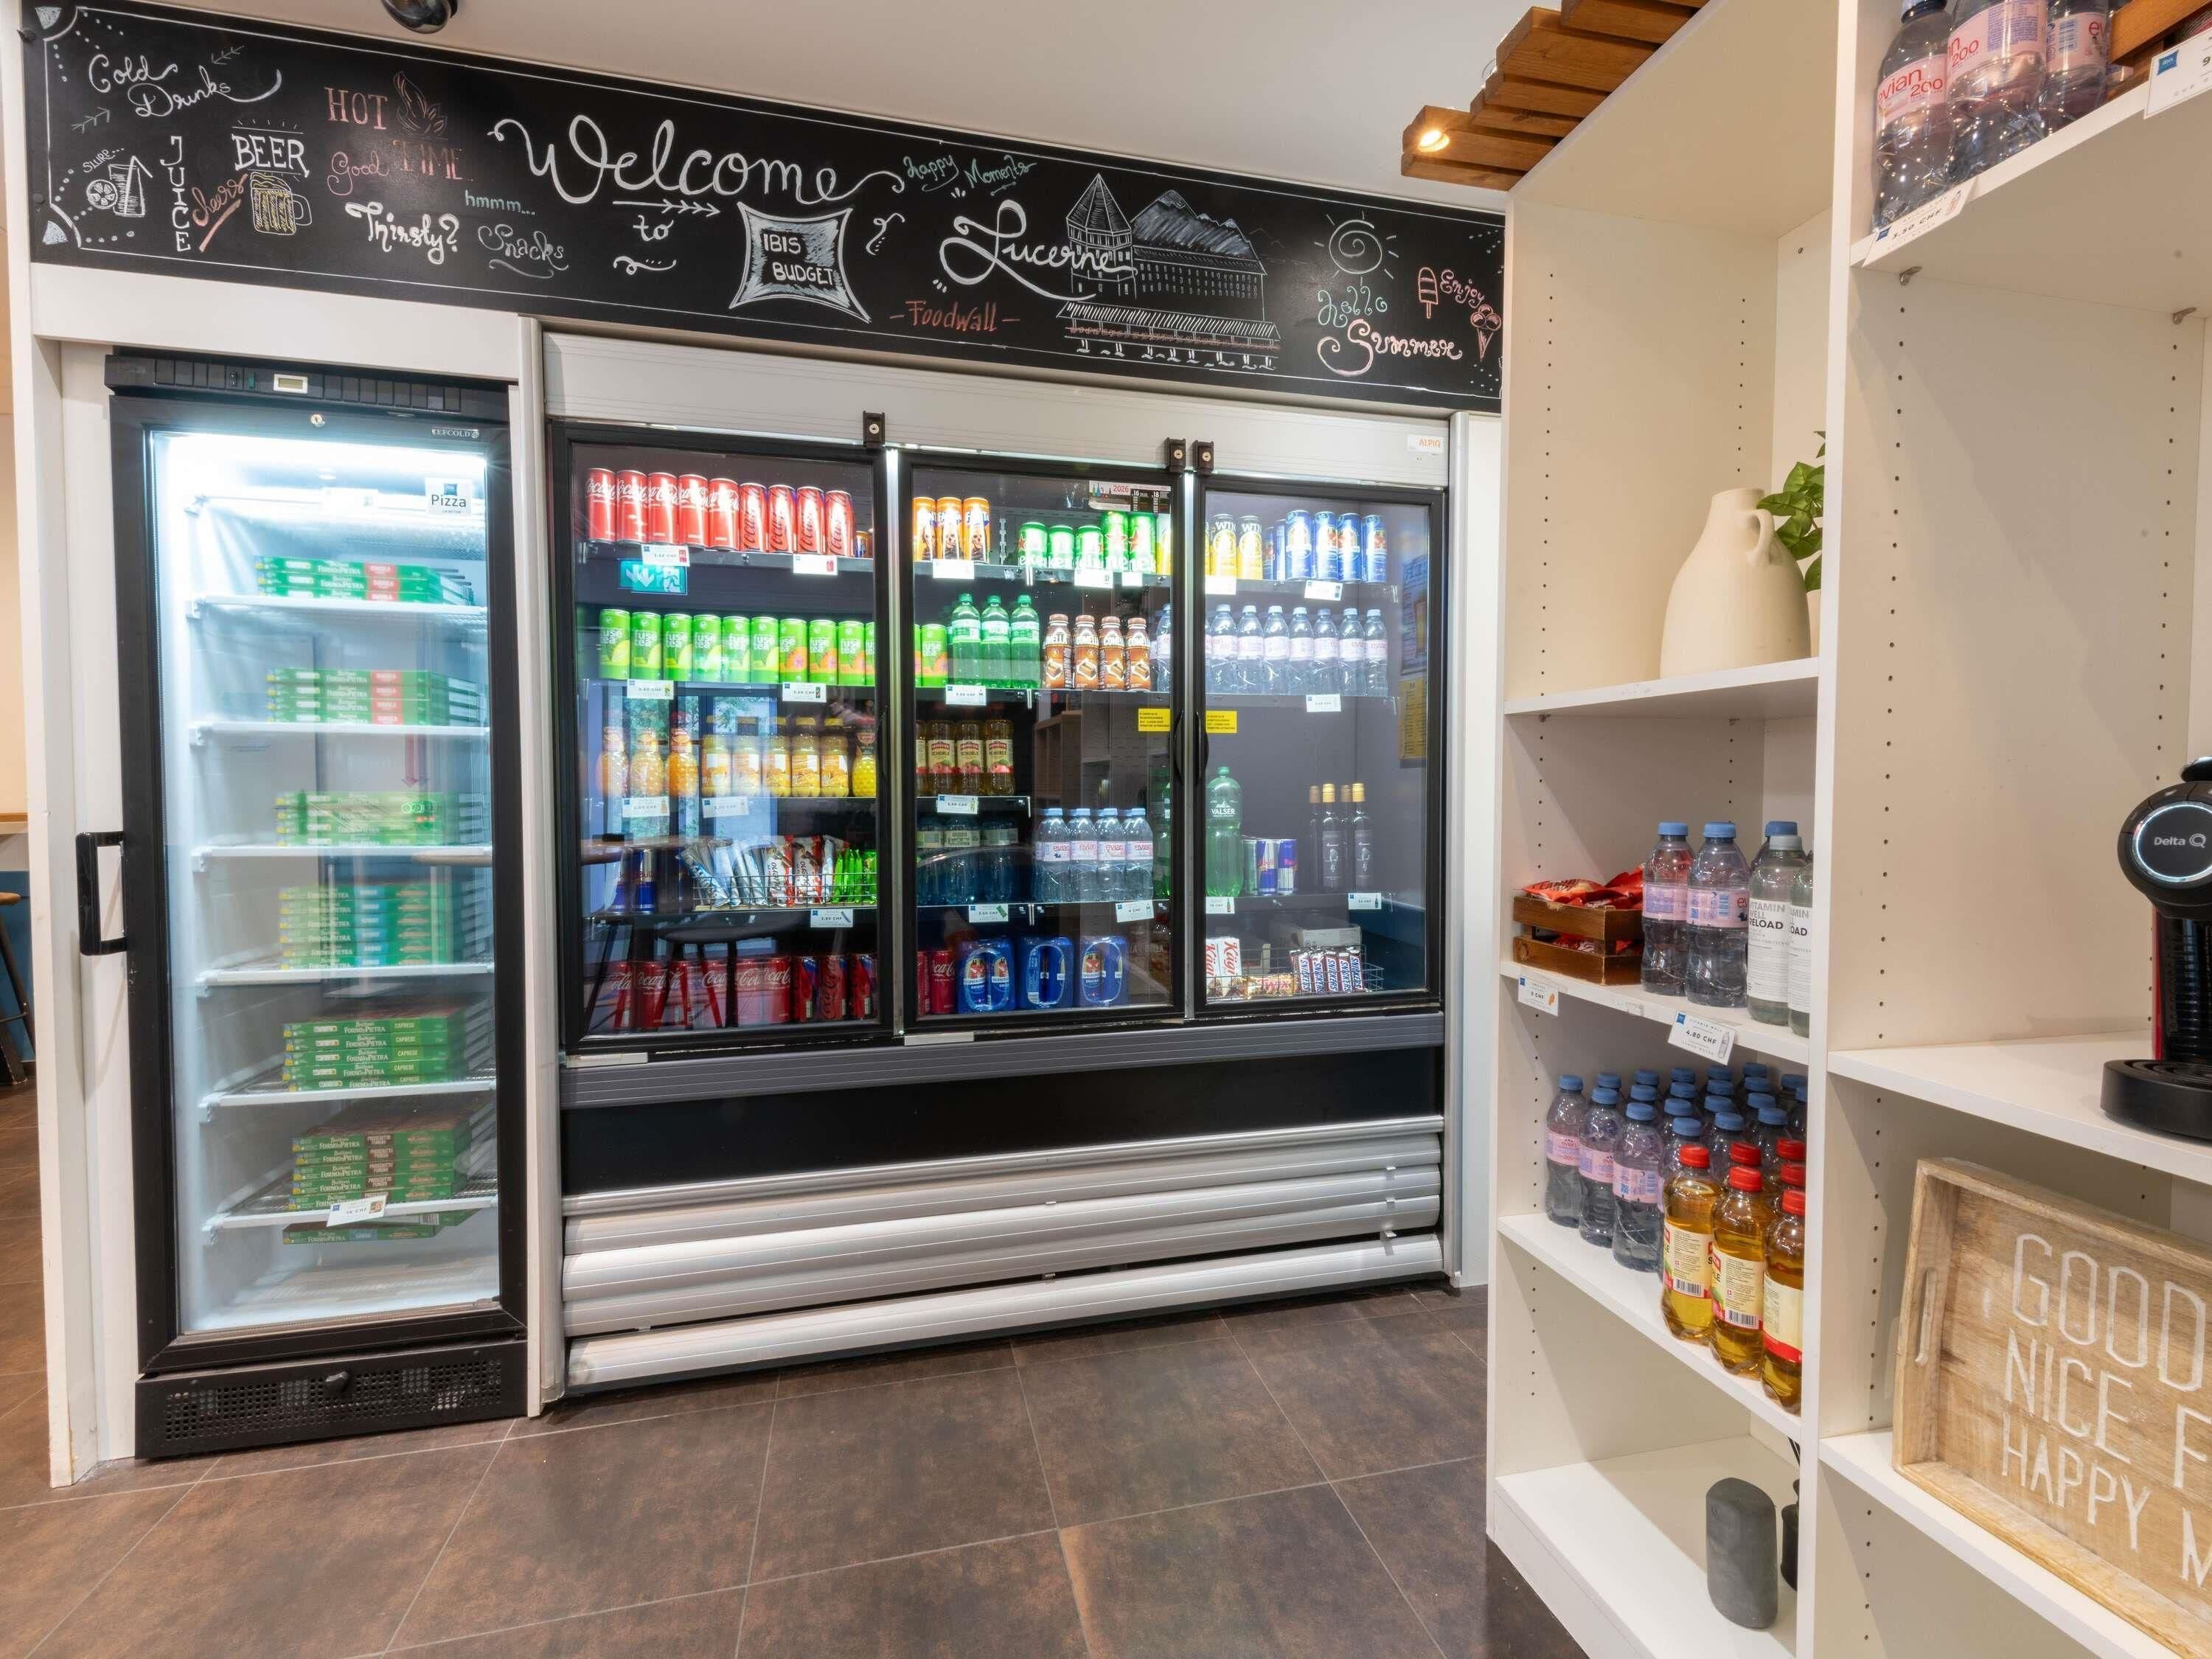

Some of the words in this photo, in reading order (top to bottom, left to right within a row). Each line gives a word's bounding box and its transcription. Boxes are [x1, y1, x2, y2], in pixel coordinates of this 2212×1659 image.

[1951, 39, 1980, 68] 200
[88, 55, 178, 92] Cold
[128, 65, 282, 117] Drinks
[1910, 77, 1943, 97] 200
[324, 86, 389, 131] HOT
[231, 133, 309, 178] BEER
[328, 152, 389, 195] Good
[487, 114, 905, 204] Welcome
[964, 153, 1037, 187] Moments
[159, 136, 191, 252] JUICE
[345, 201, 460, 265] Thirsty?
[633, 215, 674, 241] to
[762, 231, 801, 255] IBIS
[478, 223, 568, 271] Snacks
[939, 199, 1138, 301] Lucerne
[773, 262, 835, 286] BUDGET
[1439, 270, 1485, 305] Enjoy
[1318, 319, 1463, 377] Summer
[431, 494, 467, 507] Pizza
[2154, 836, 2186, 846] Delta
[2188, 833, 2207, 849] Q
[1223, 938, 1239, 975] Kägi
[1299, 958, 1311, 992] SNICKERS
[1327, 958, 1338, 992] SNICKERS
[1350, 956, 1363, 990] SNICKERS
[1340, 960, 1352, 993] SNICKERS
[1703, 1036, 1717, 1045] CHF
[2012, 1233, 2207, 1392] GOOD
[2003, 1327, 2133, 1464] NICE
[2000, 1408, 2151, 1553] HAPPY
